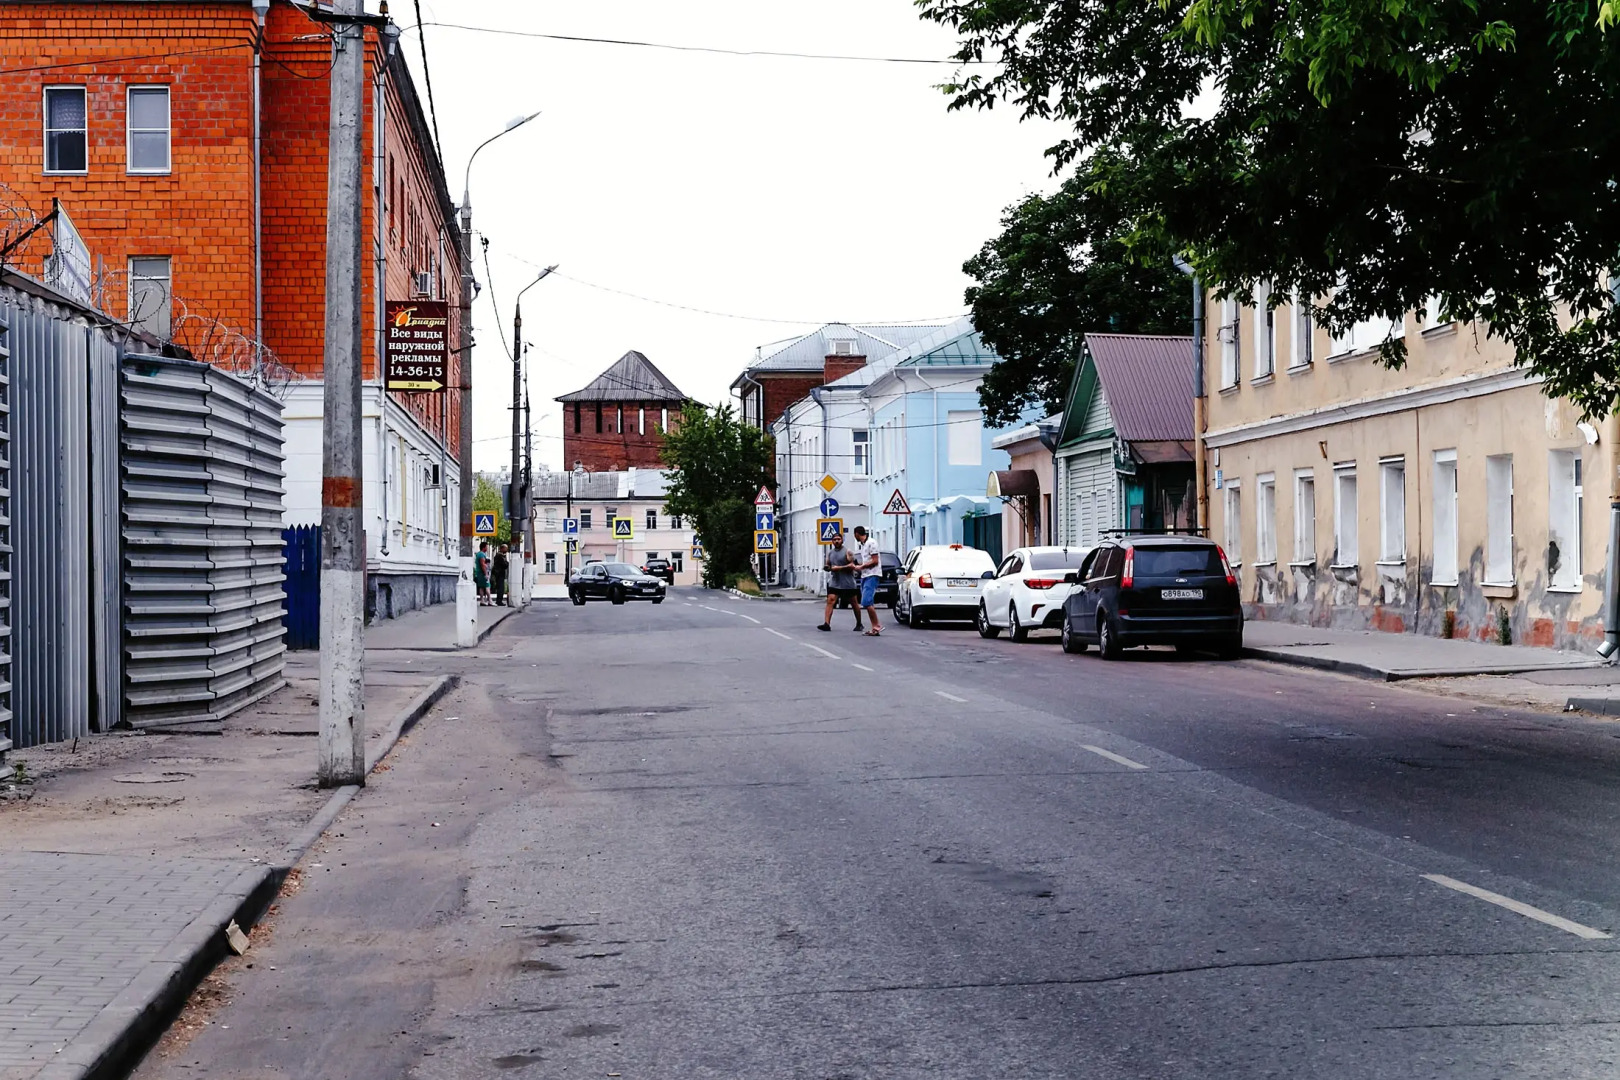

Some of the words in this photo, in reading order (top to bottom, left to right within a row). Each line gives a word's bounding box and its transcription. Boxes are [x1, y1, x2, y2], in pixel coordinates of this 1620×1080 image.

[391, 328, 411, 338] Все
[414, 330, 443, 339] виды
[388, 341, 445, 352] наружной
[391, 354, 442, 364] рекламы
[390, 365, 443, 376] 14-36-13
